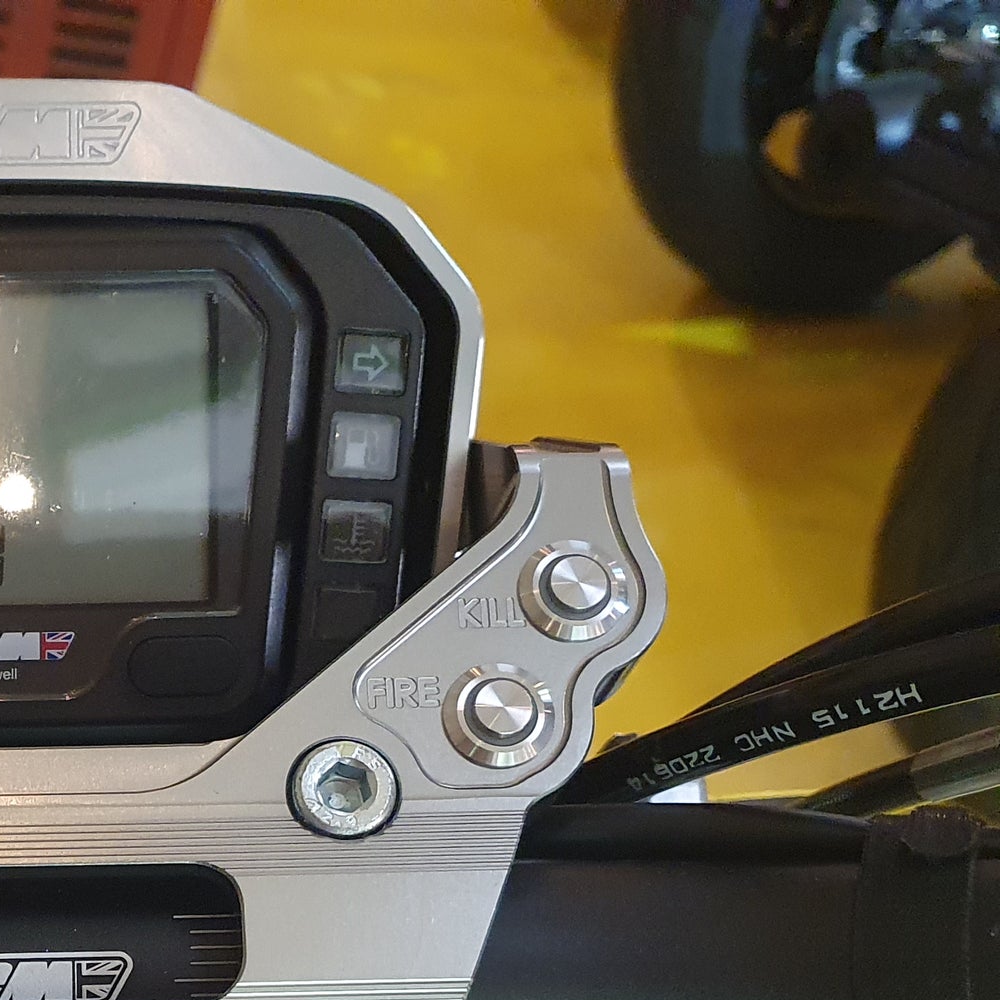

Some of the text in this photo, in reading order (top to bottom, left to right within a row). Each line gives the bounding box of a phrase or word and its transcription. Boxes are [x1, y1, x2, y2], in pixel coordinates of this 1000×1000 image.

[457, 597, 528, 629] KILL
[365, 675, 441, 709] FIRE
[811, 682, 924, 730] H2115
[733, 720, 797, 753] NHC
